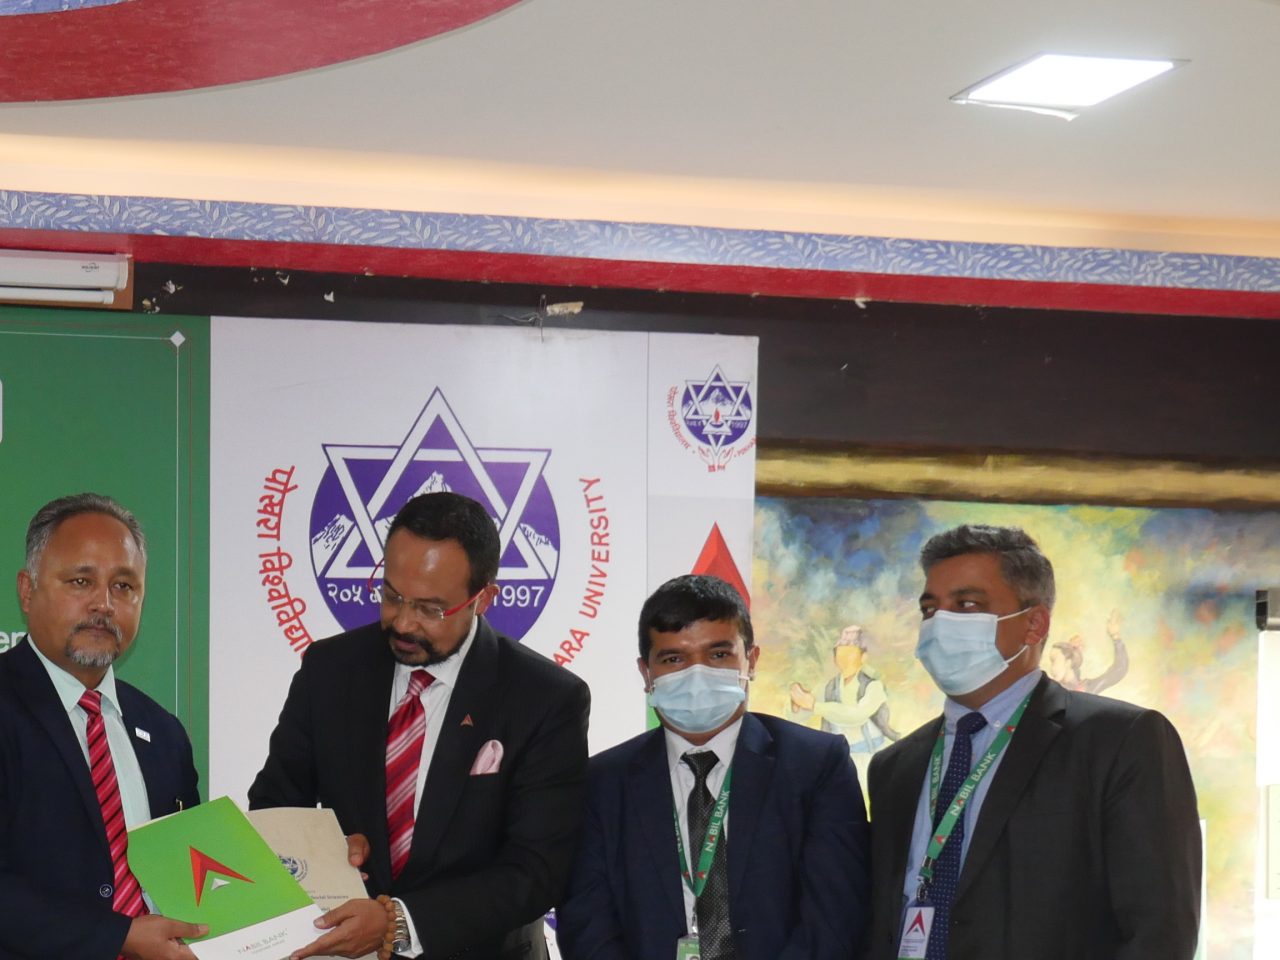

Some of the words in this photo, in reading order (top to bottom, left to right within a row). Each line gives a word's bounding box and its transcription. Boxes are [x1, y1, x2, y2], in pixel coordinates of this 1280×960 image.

[256, 466, 298, 541] पोखरा
[259, 546, 315, 661] विश्वविद्या
[552, 629, 590, 667] ARA
[579, 478, 610, 618] UNIVERSITY
[714, 790, 731, 818] BANK
[970, 752, 996, 781] BANK
